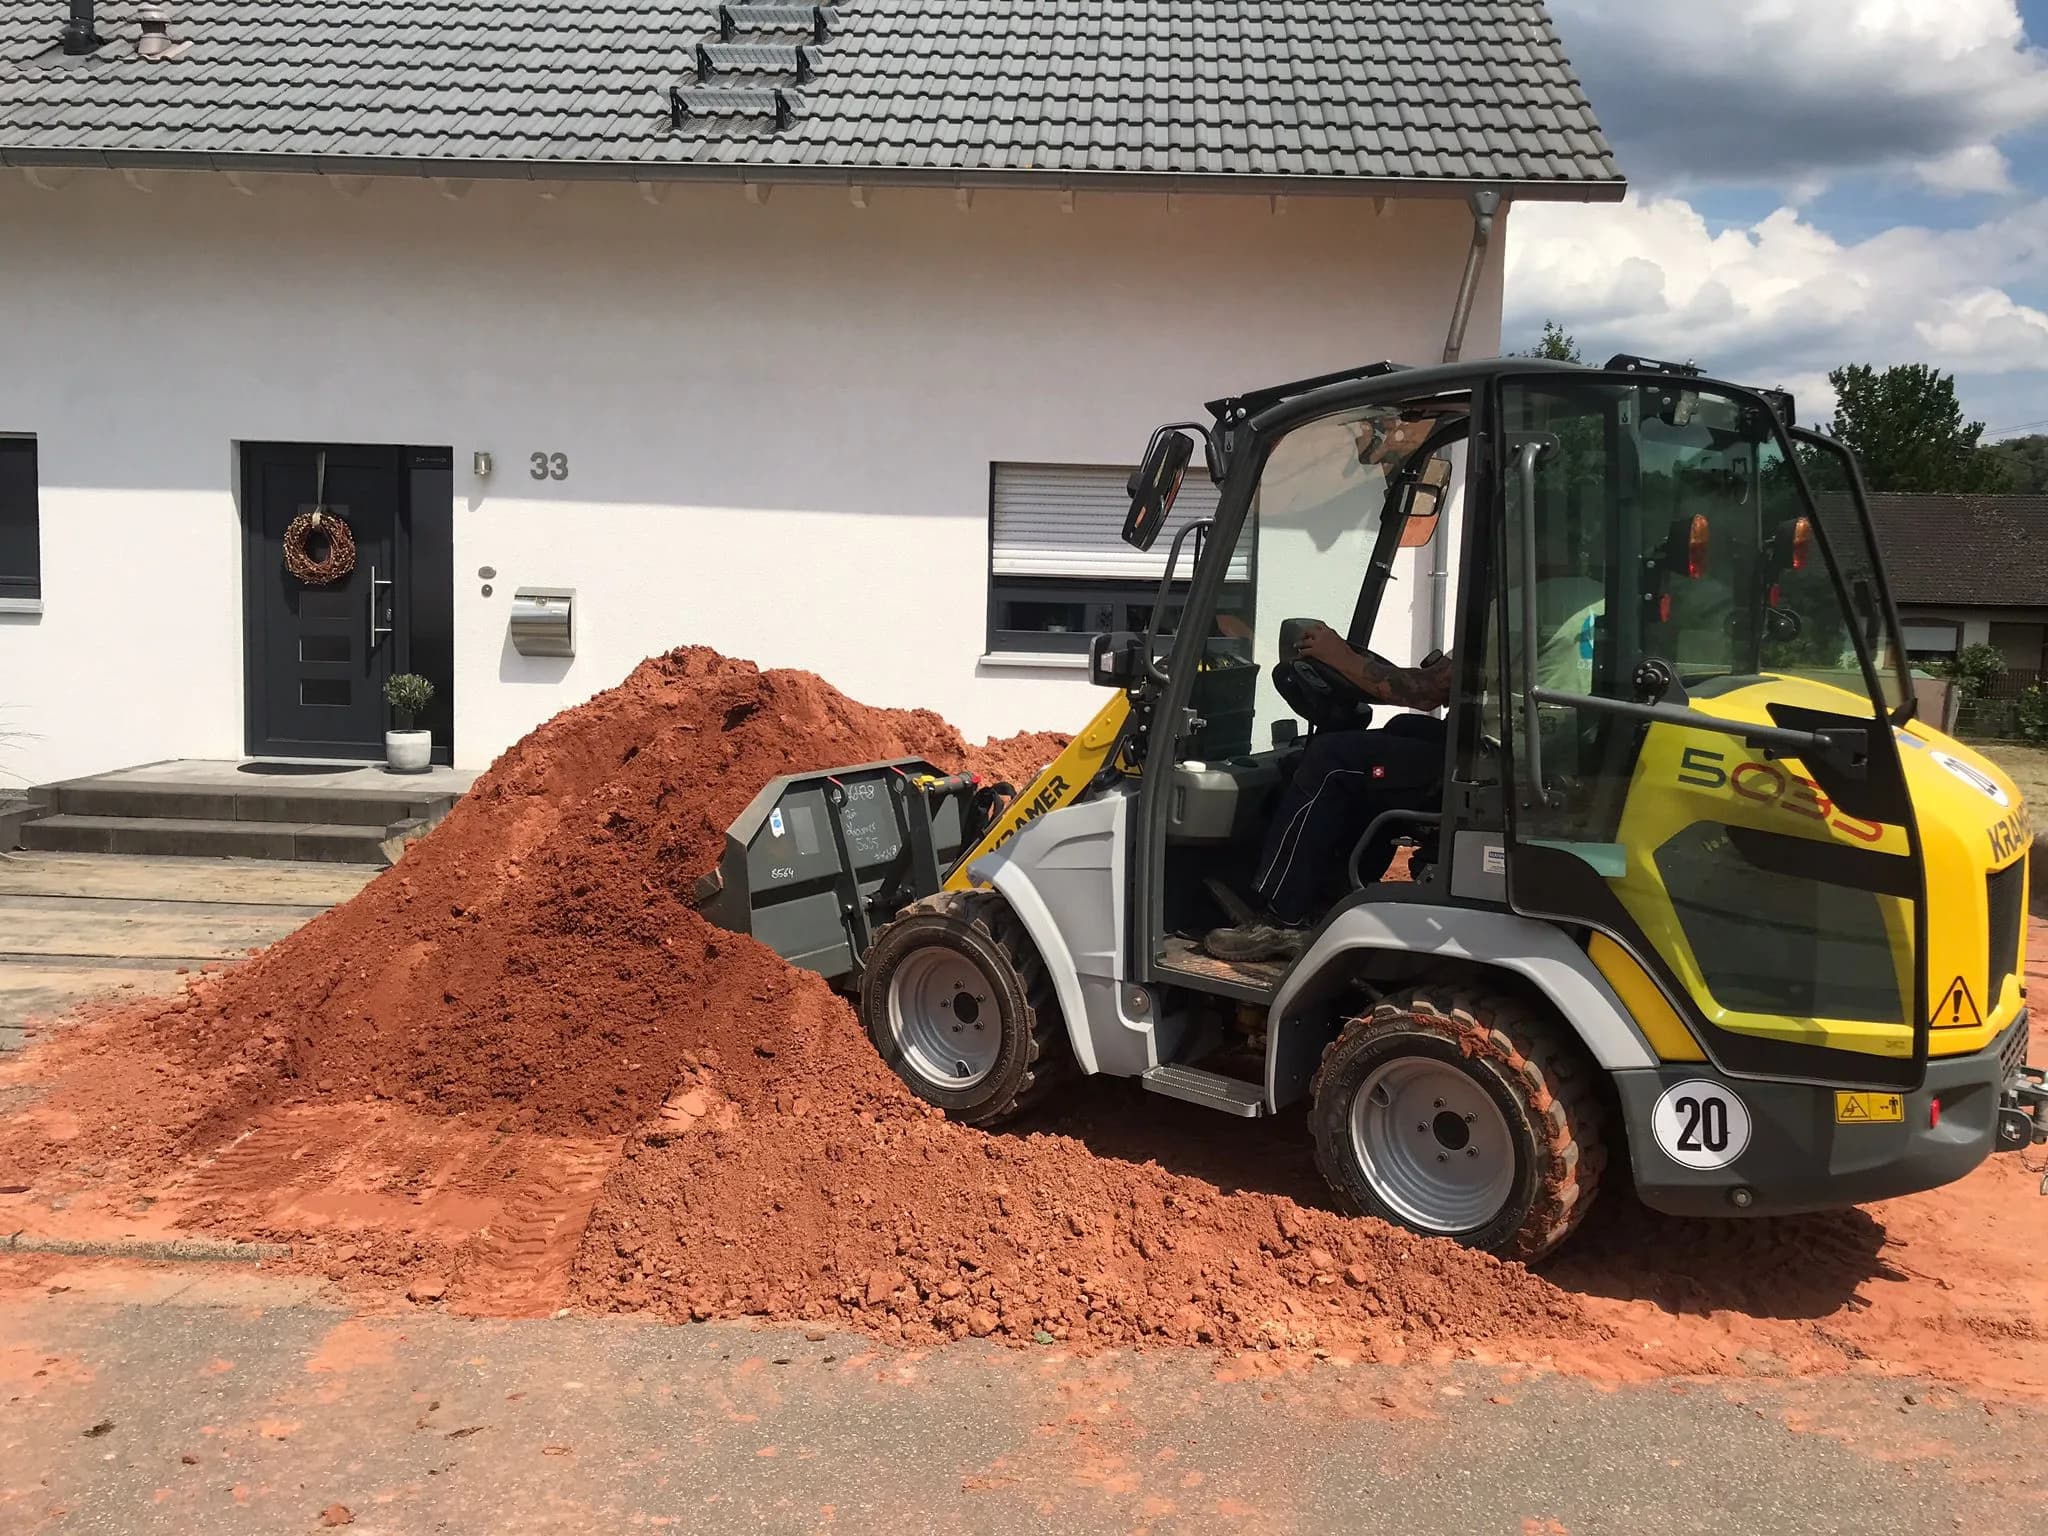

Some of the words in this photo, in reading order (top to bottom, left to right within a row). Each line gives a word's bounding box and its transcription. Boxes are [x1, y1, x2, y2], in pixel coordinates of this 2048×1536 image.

[530, 451, 568, 481] 33
[988, 775, 1071, 853] AMER
[1675, 1096, 1728, 1152] 20
